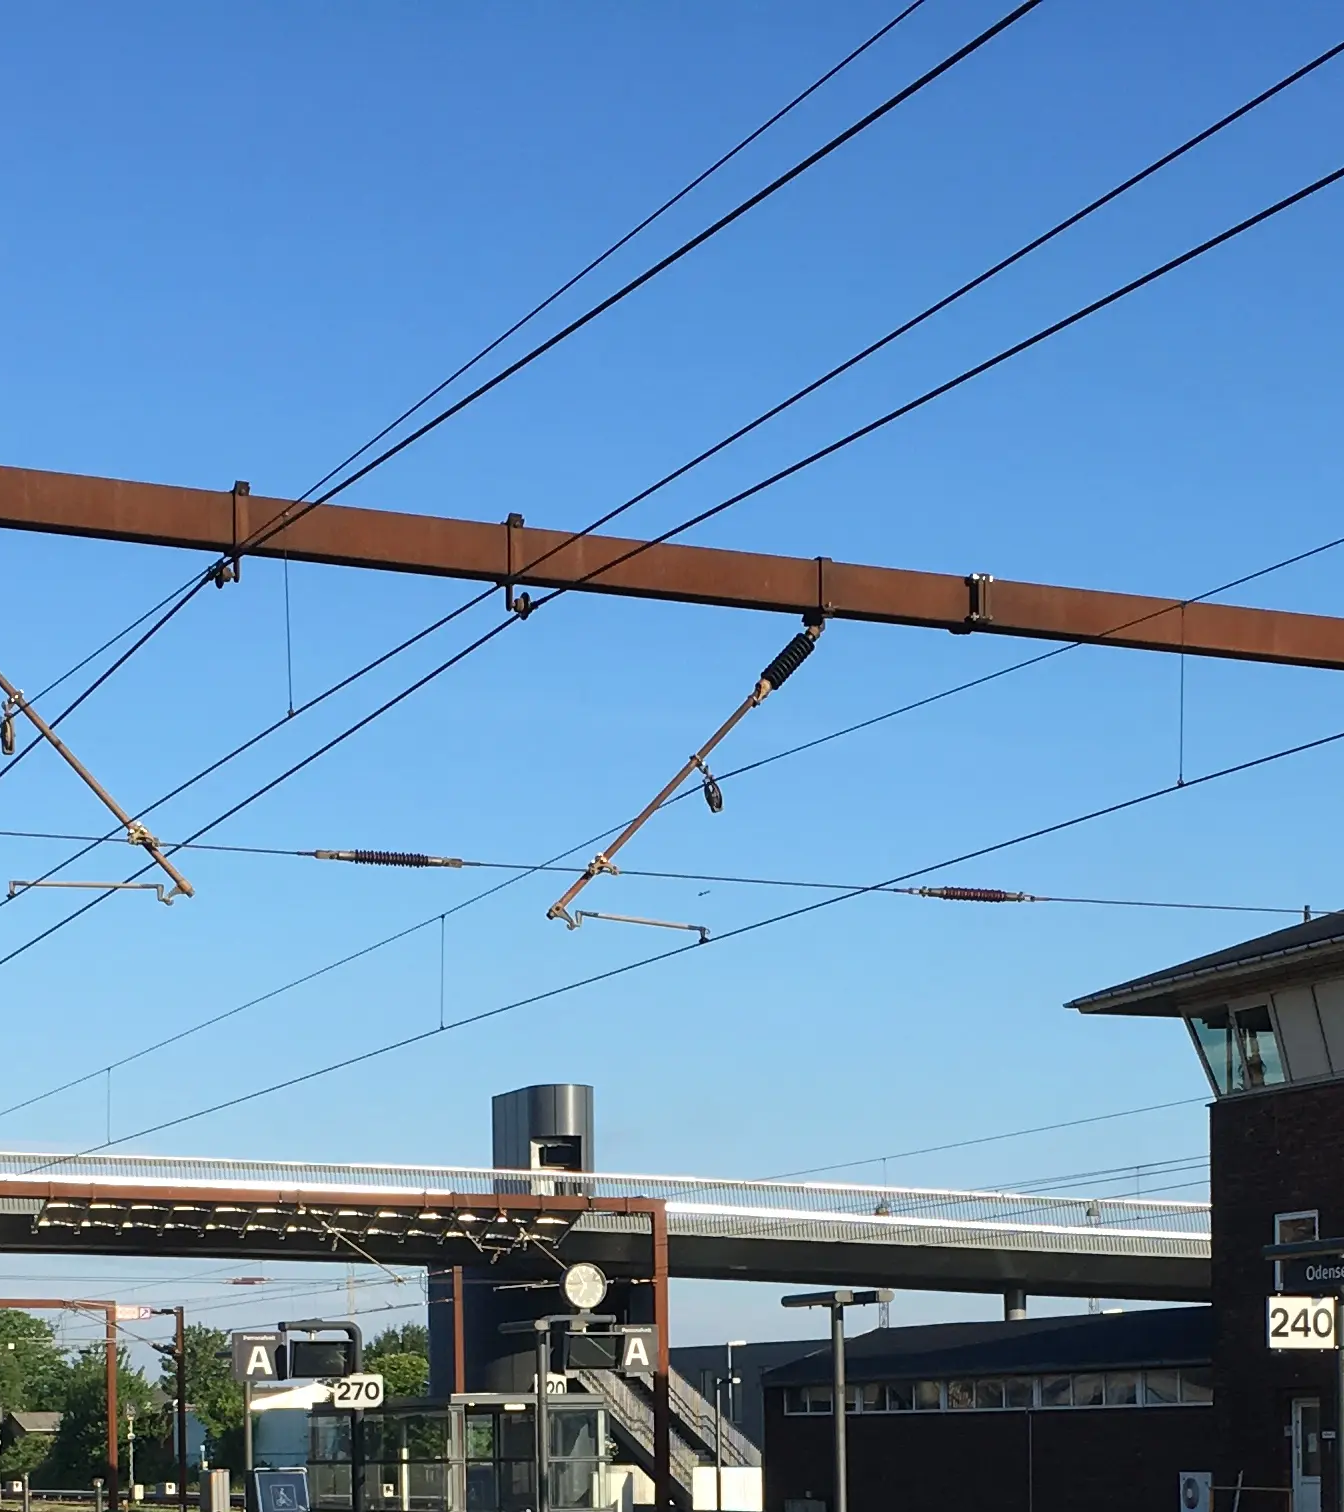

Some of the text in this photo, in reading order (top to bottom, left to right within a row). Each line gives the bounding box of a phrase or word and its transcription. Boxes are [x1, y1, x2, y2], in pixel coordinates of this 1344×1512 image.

[1271, 1307, 1333, 1338] 240
[247, 1345, 273, 1375] A
[625, 1337, 649, 1366] A
[337, 1382, 380, 1400] 270
[546, 1380, 565, 1394] 20
